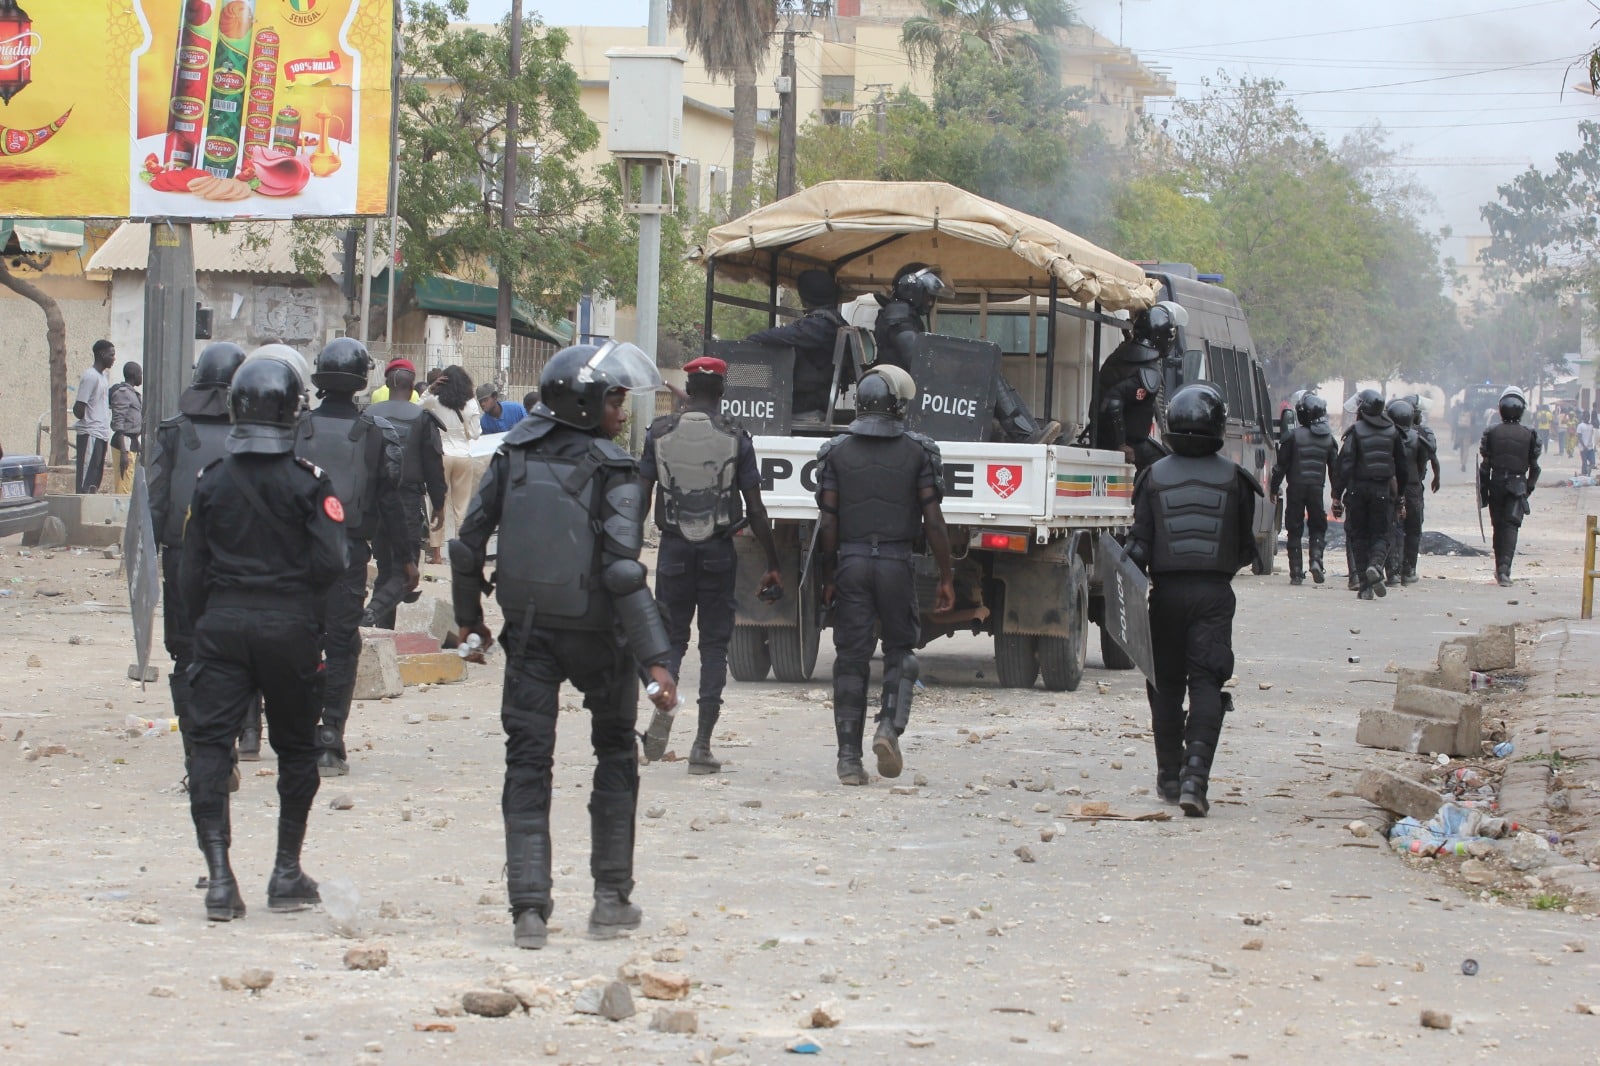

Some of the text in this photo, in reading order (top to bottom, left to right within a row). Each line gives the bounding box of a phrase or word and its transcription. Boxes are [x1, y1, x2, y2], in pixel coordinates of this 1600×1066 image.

[289, 11, 321, 23] SENEGAL
[290, 61, 335, 73] 100% HALAL
[720, 398, 775, 419] POLICE
[921, 393, 978, 418] POLICE
